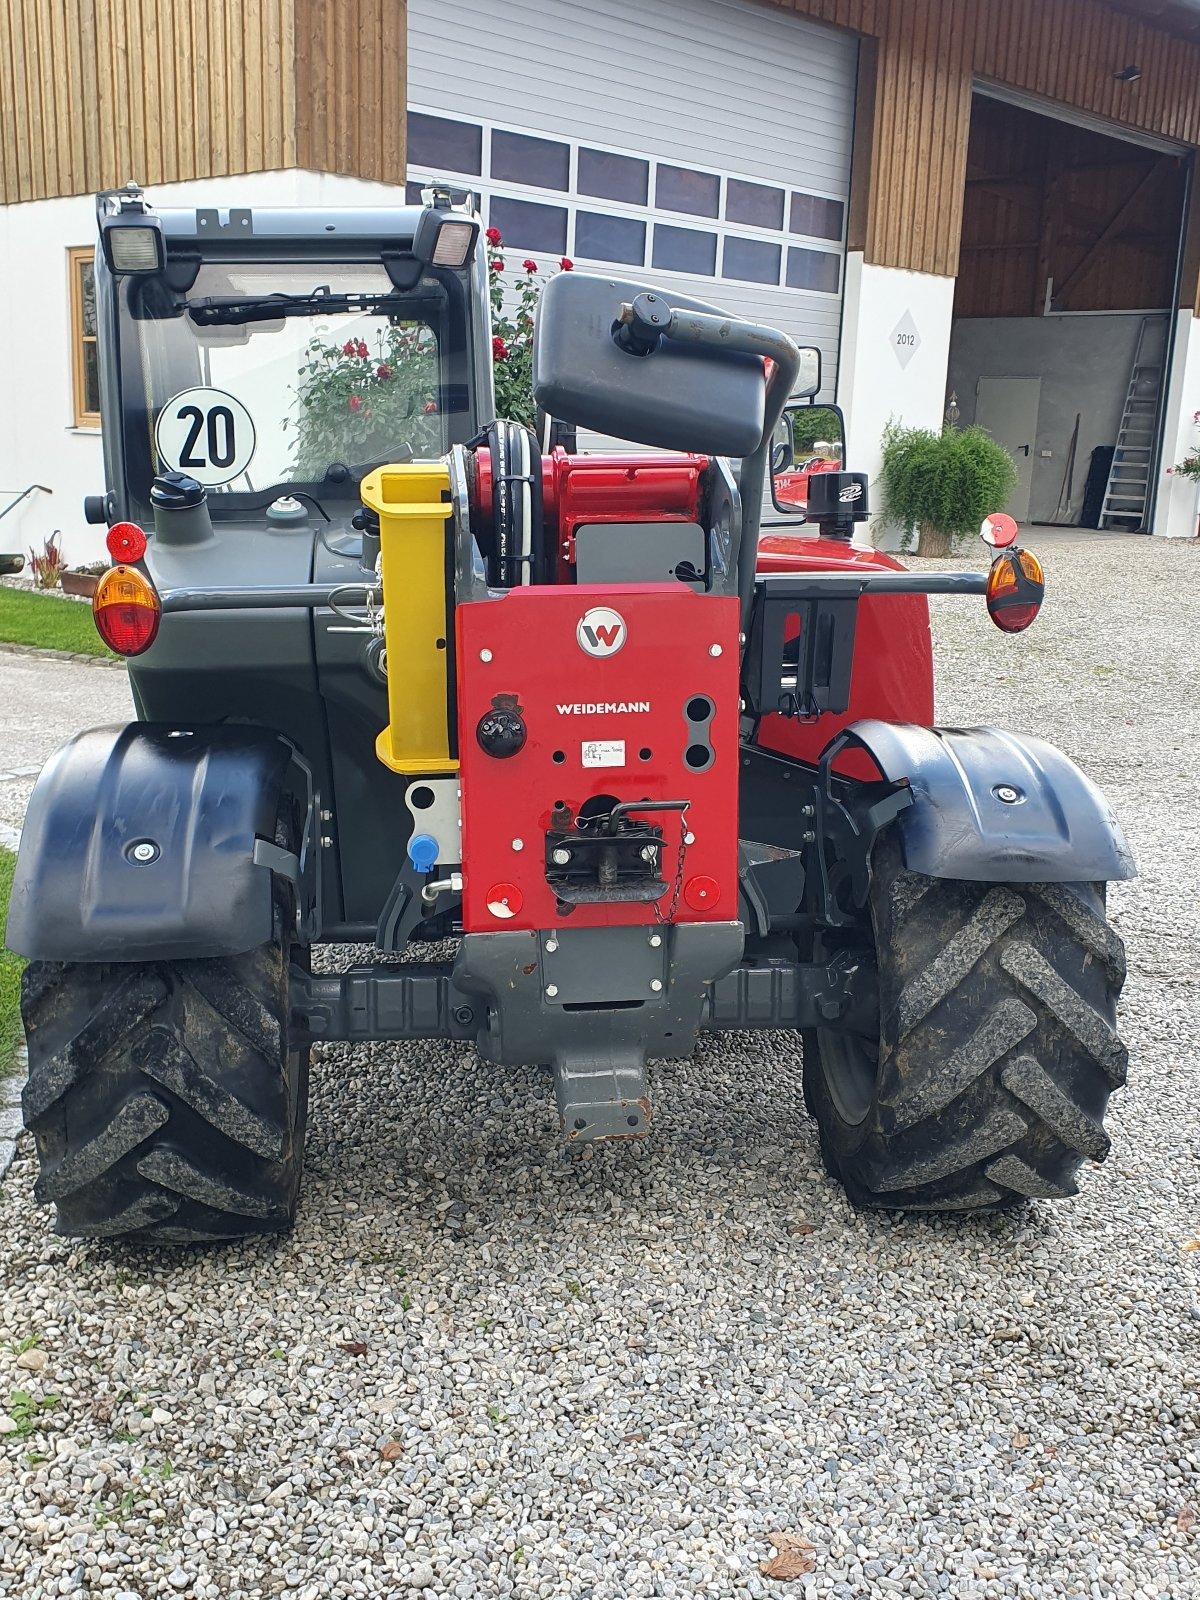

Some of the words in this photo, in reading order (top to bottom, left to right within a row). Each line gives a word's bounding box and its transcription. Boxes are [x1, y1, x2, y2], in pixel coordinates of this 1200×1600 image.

[896, 333, 915, 346] 2012
[176, 405, 236, 469] 20
[556, 701, 650, 715] WEIDEMANN
